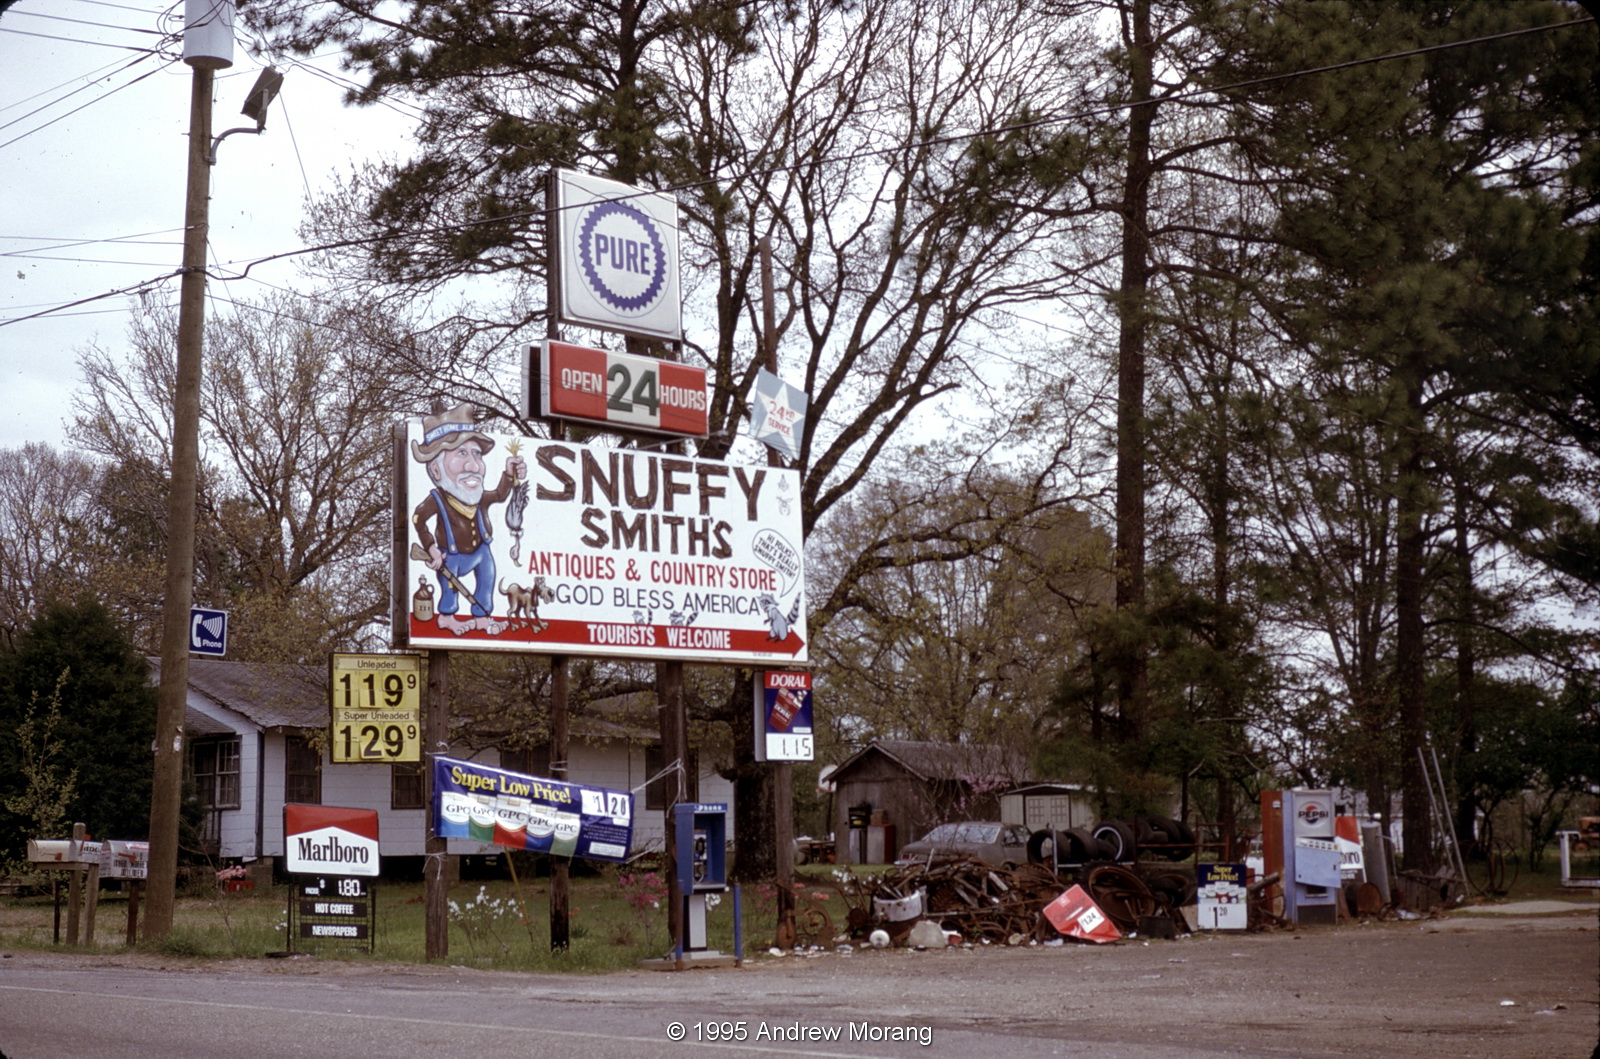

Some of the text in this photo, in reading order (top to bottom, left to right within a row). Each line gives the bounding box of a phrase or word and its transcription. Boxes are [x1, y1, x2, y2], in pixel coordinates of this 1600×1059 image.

[594, 233, 650, 276] PURE
[561, 363, 706, 417] OPEN 24 HOURS
[535, 444, 767, 522] SNUFFY
[580, 506, 733, 560] SMITH'S
[528, 551, 777, 591] ANTIQUES & COUNTRY STORE
[555, 583, 761, 616] GOD BLESS AMERICA
[202, 639, 222, 648] Phone
[587, 624, 731, 649] TOURISTS WELCOME
[357, 660, 397, 669] Unleaded
[770, 674, 807, 688] DORAL
[344, 711, 410, 721] Super Unleaded
[782, 737, 811, 757] 1.15
[451, 766, 572, 804] Super Low Price!
[446, 804, 471, 814] GPC
[473, 805, 495, 817] GPC
[498, 809, 526, 822] GPC
[529, 816, 553, 828] GPC
[556, 822, 577, 833] GPC
[297, 836, 369, 864] Marlboro
[338, 879, 360, 896] 1.80
[315, 903, 354, 914] HOT COFFEE
[312, 925, 357, 937] NEWSPAPERS
